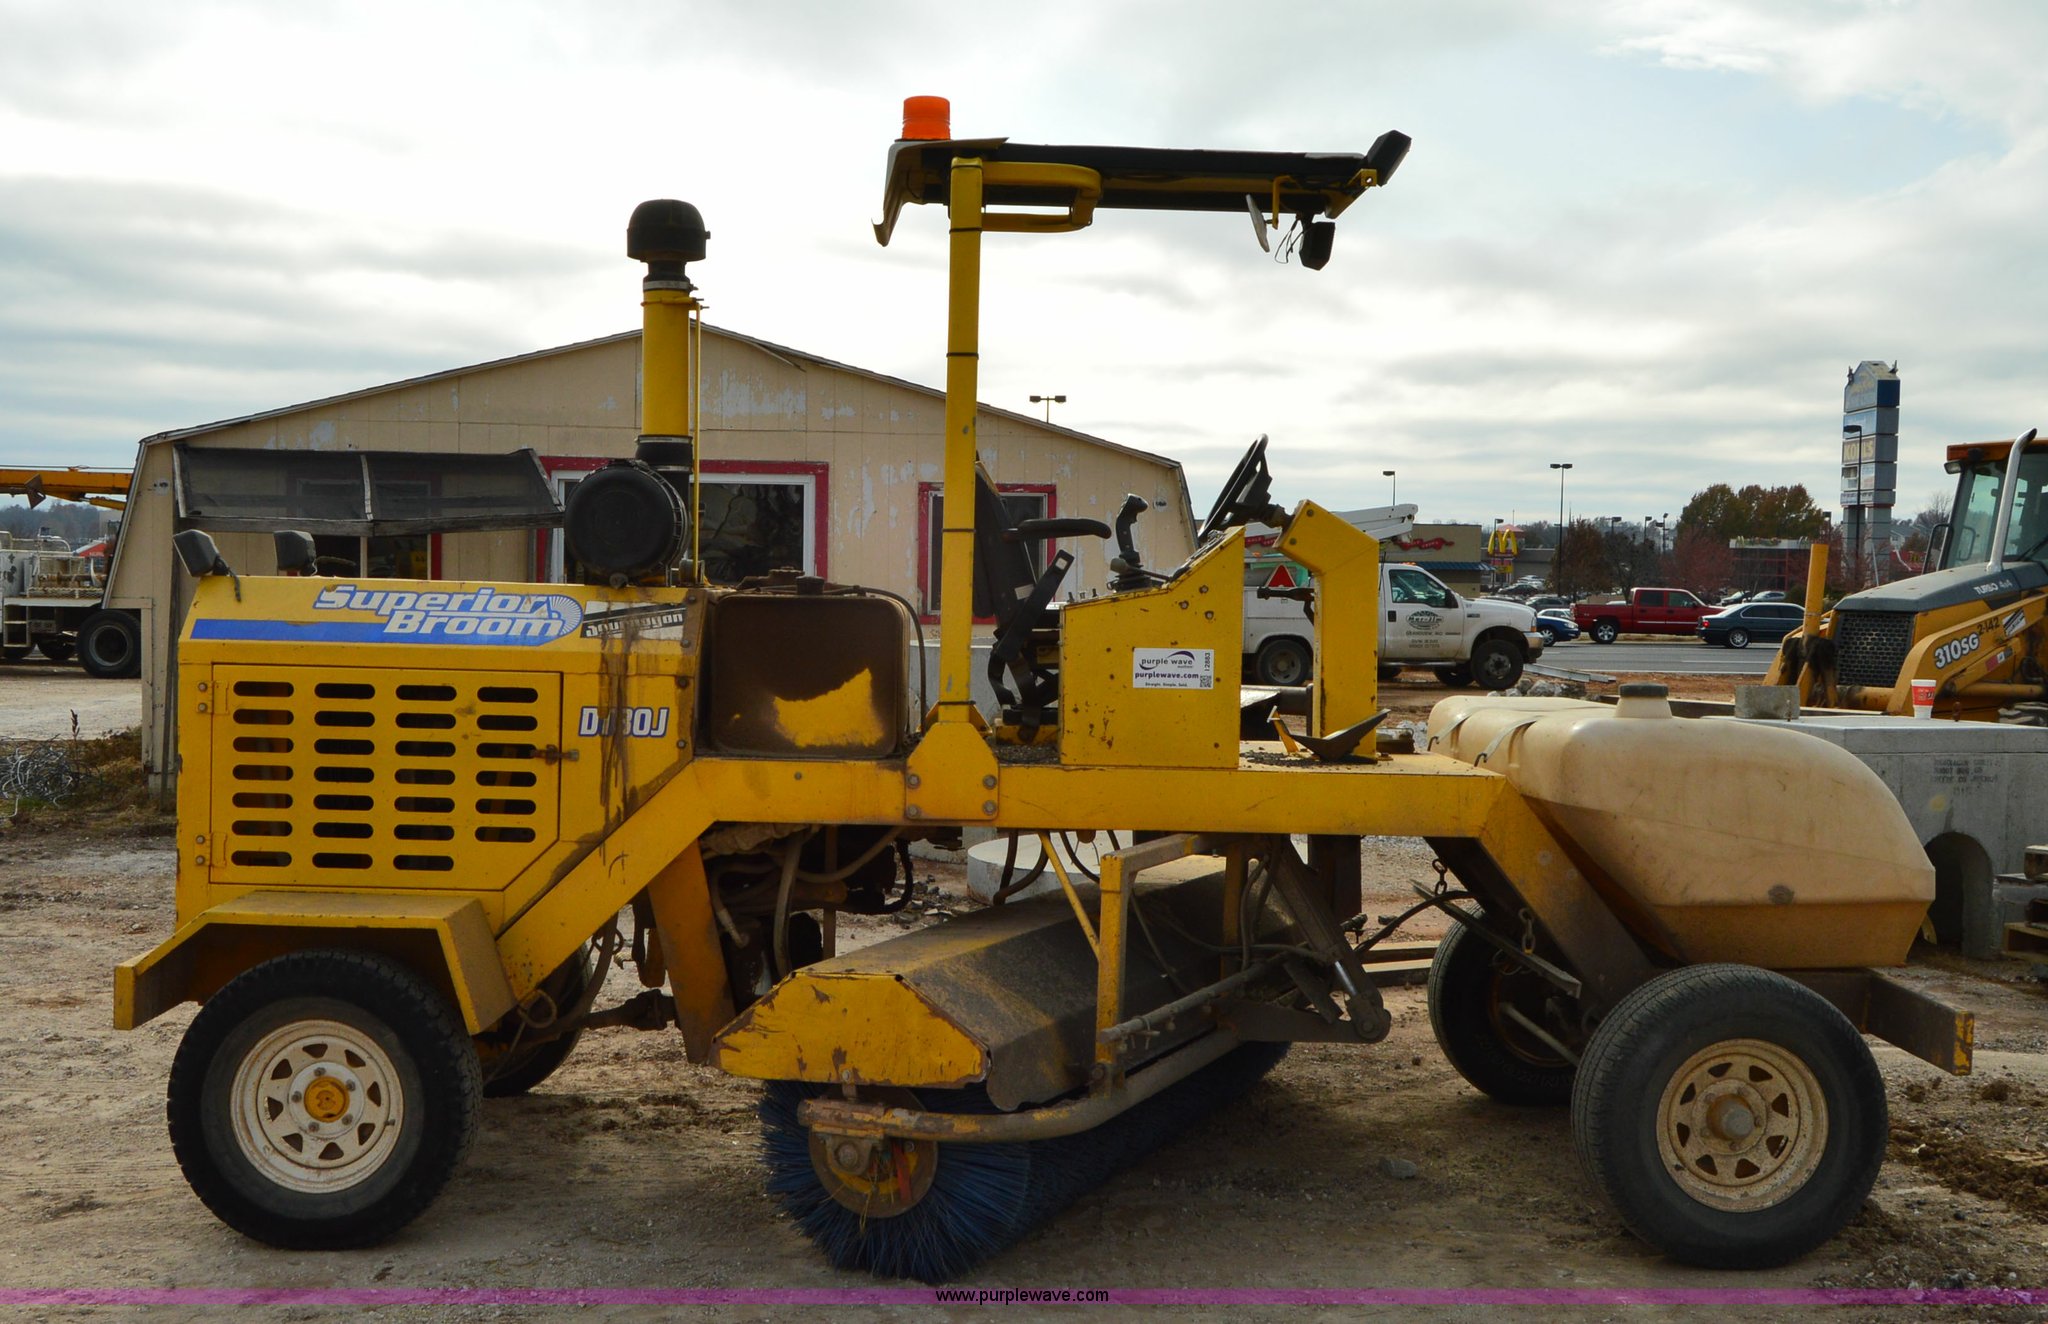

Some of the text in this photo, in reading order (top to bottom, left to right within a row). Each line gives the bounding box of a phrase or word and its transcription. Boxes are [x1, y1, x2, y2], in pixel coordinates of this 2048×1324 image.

[313, 584, 549, 615] Superior
[384, 610, 565, 637] Broom
[1935, 633, 1979, 668] 310SG
[1135, 671, 1199, 679] purplewave.com
